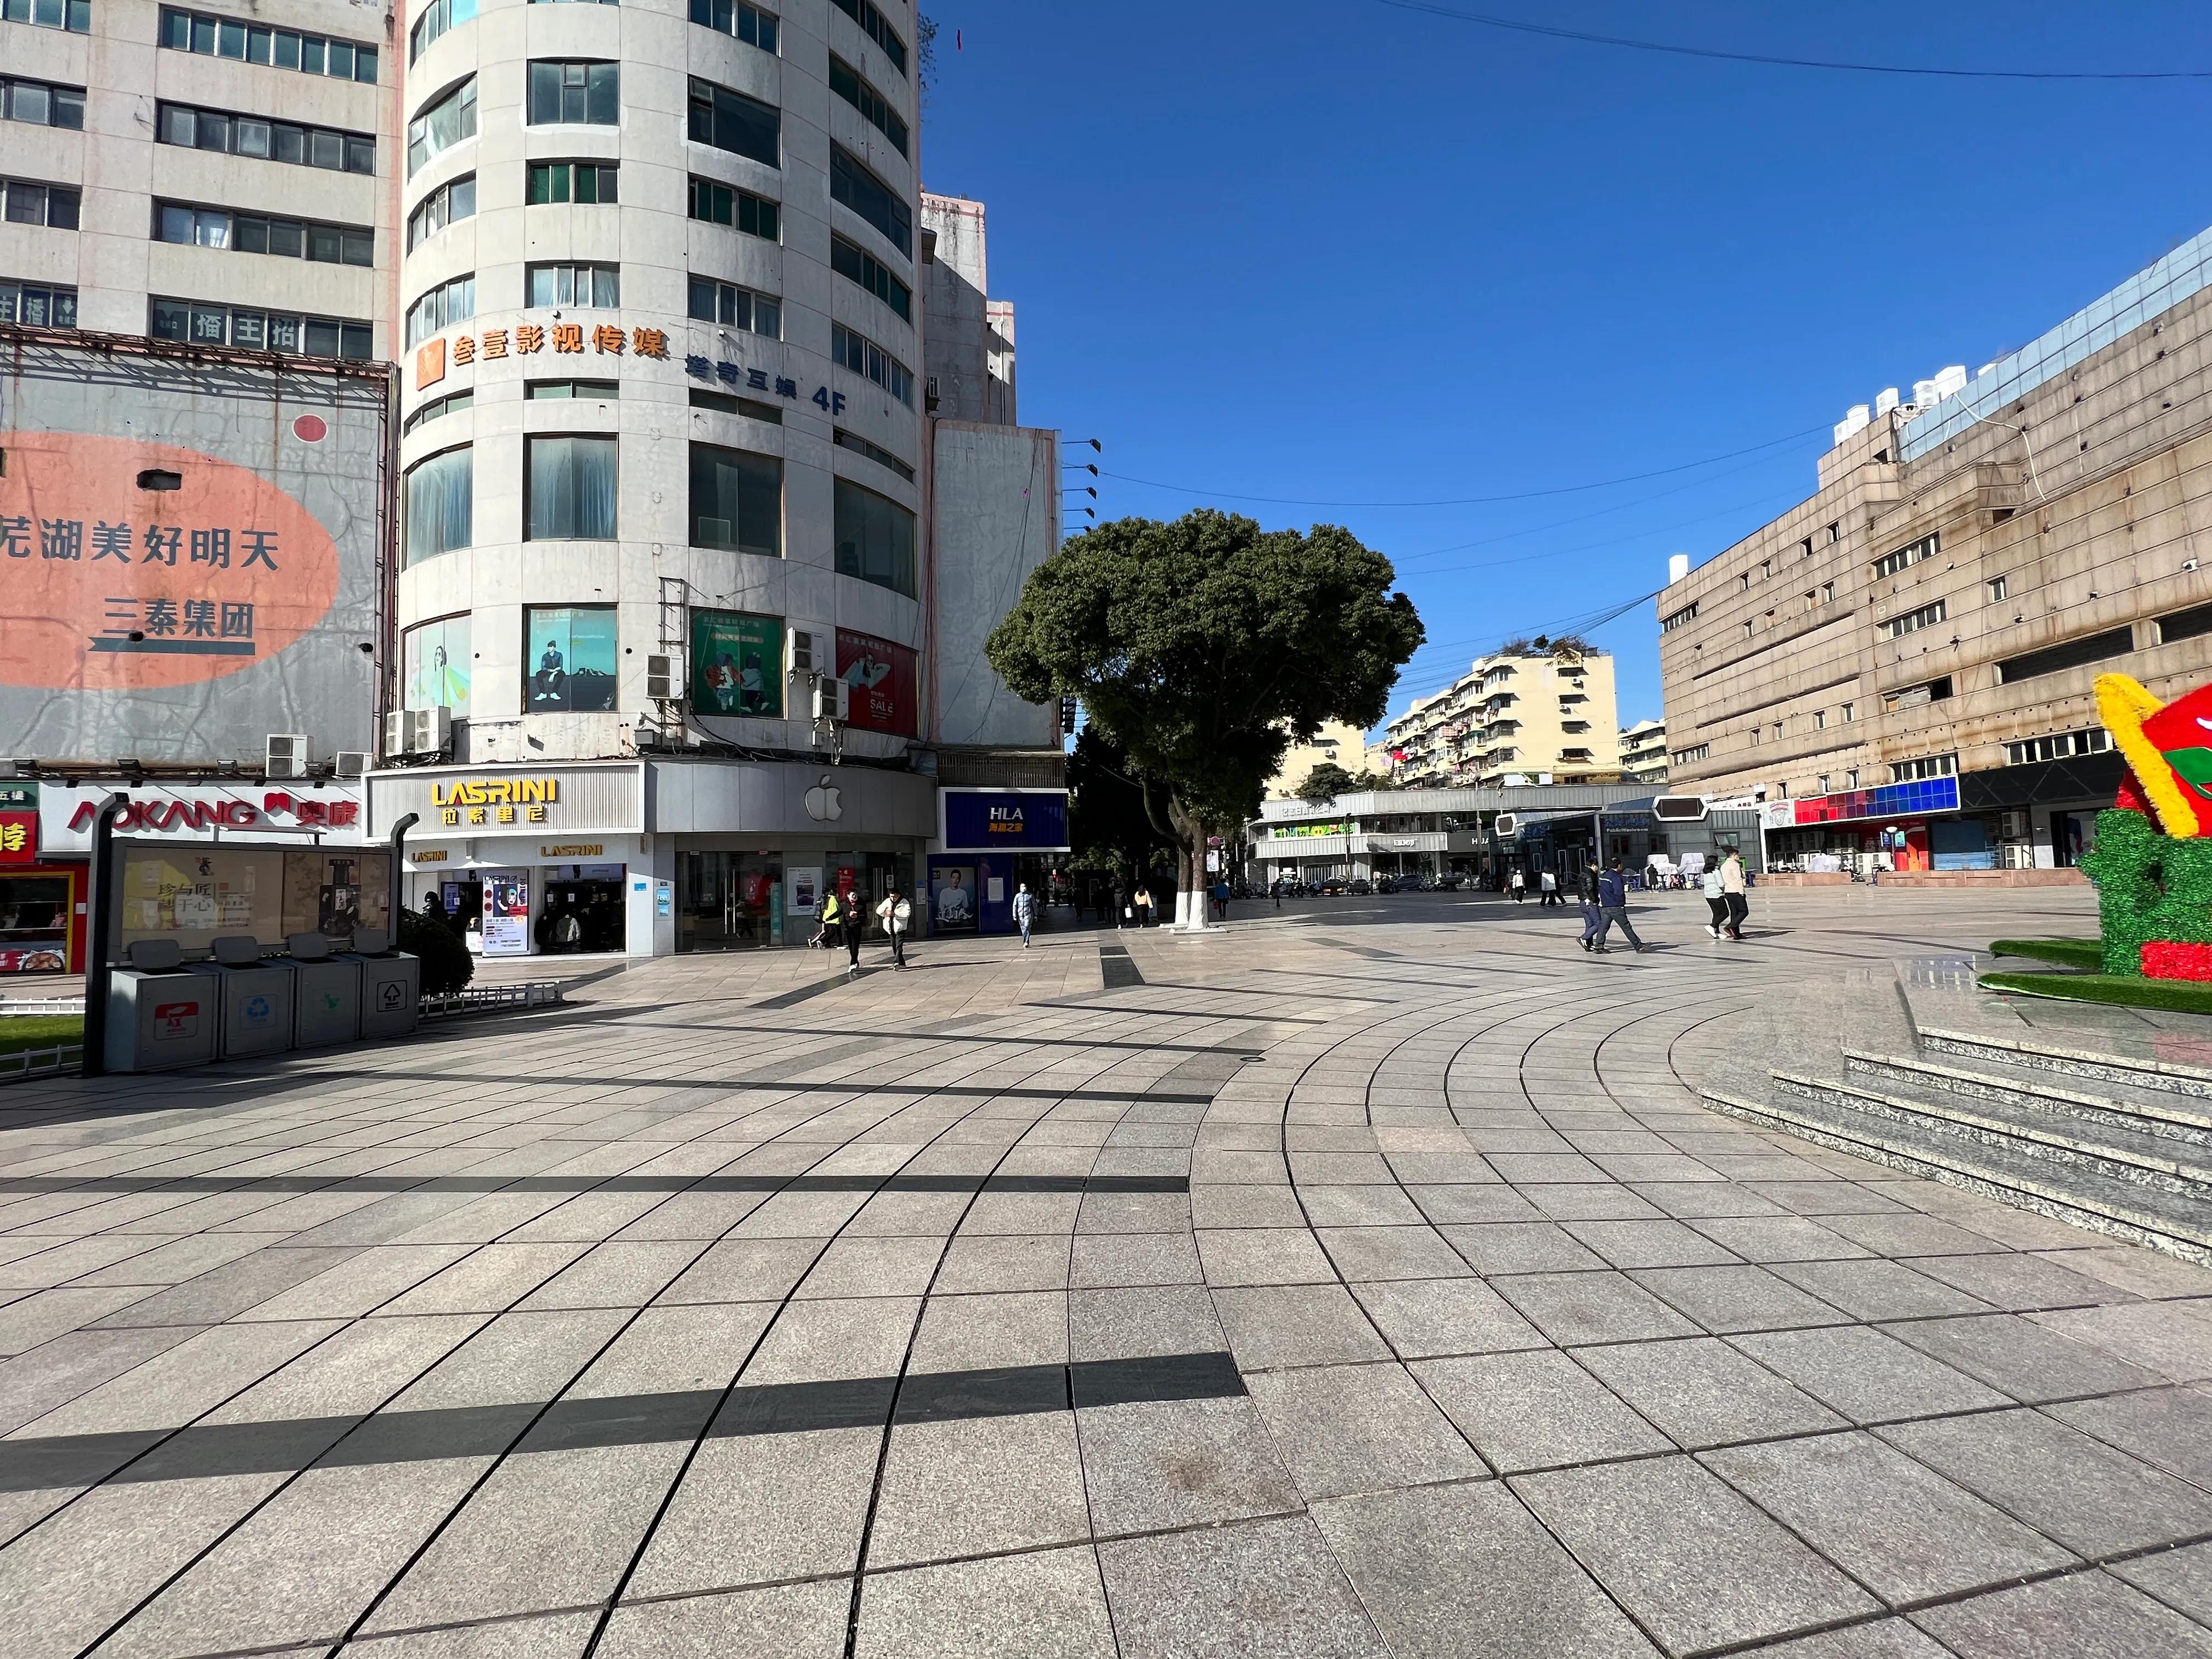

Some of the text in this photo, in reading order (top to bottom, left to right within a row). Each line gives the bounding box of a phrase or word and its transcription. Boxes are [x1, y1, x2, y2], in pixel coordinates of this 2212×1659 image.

[453, 324, 666, 366] 叁壹影视传媒
[812, 386, 845, 416] 4F
[103, 597, 255, 639] 三泰集团
[431, 779, 557, 806] LASRINI
[67, 800, 358, 829] AOKANG 奥康
[442, 806, 545, 824] 拉索里尼
[990, 807, 1023, 820] HLA
[540, 844, 602, 857] LASRINI
